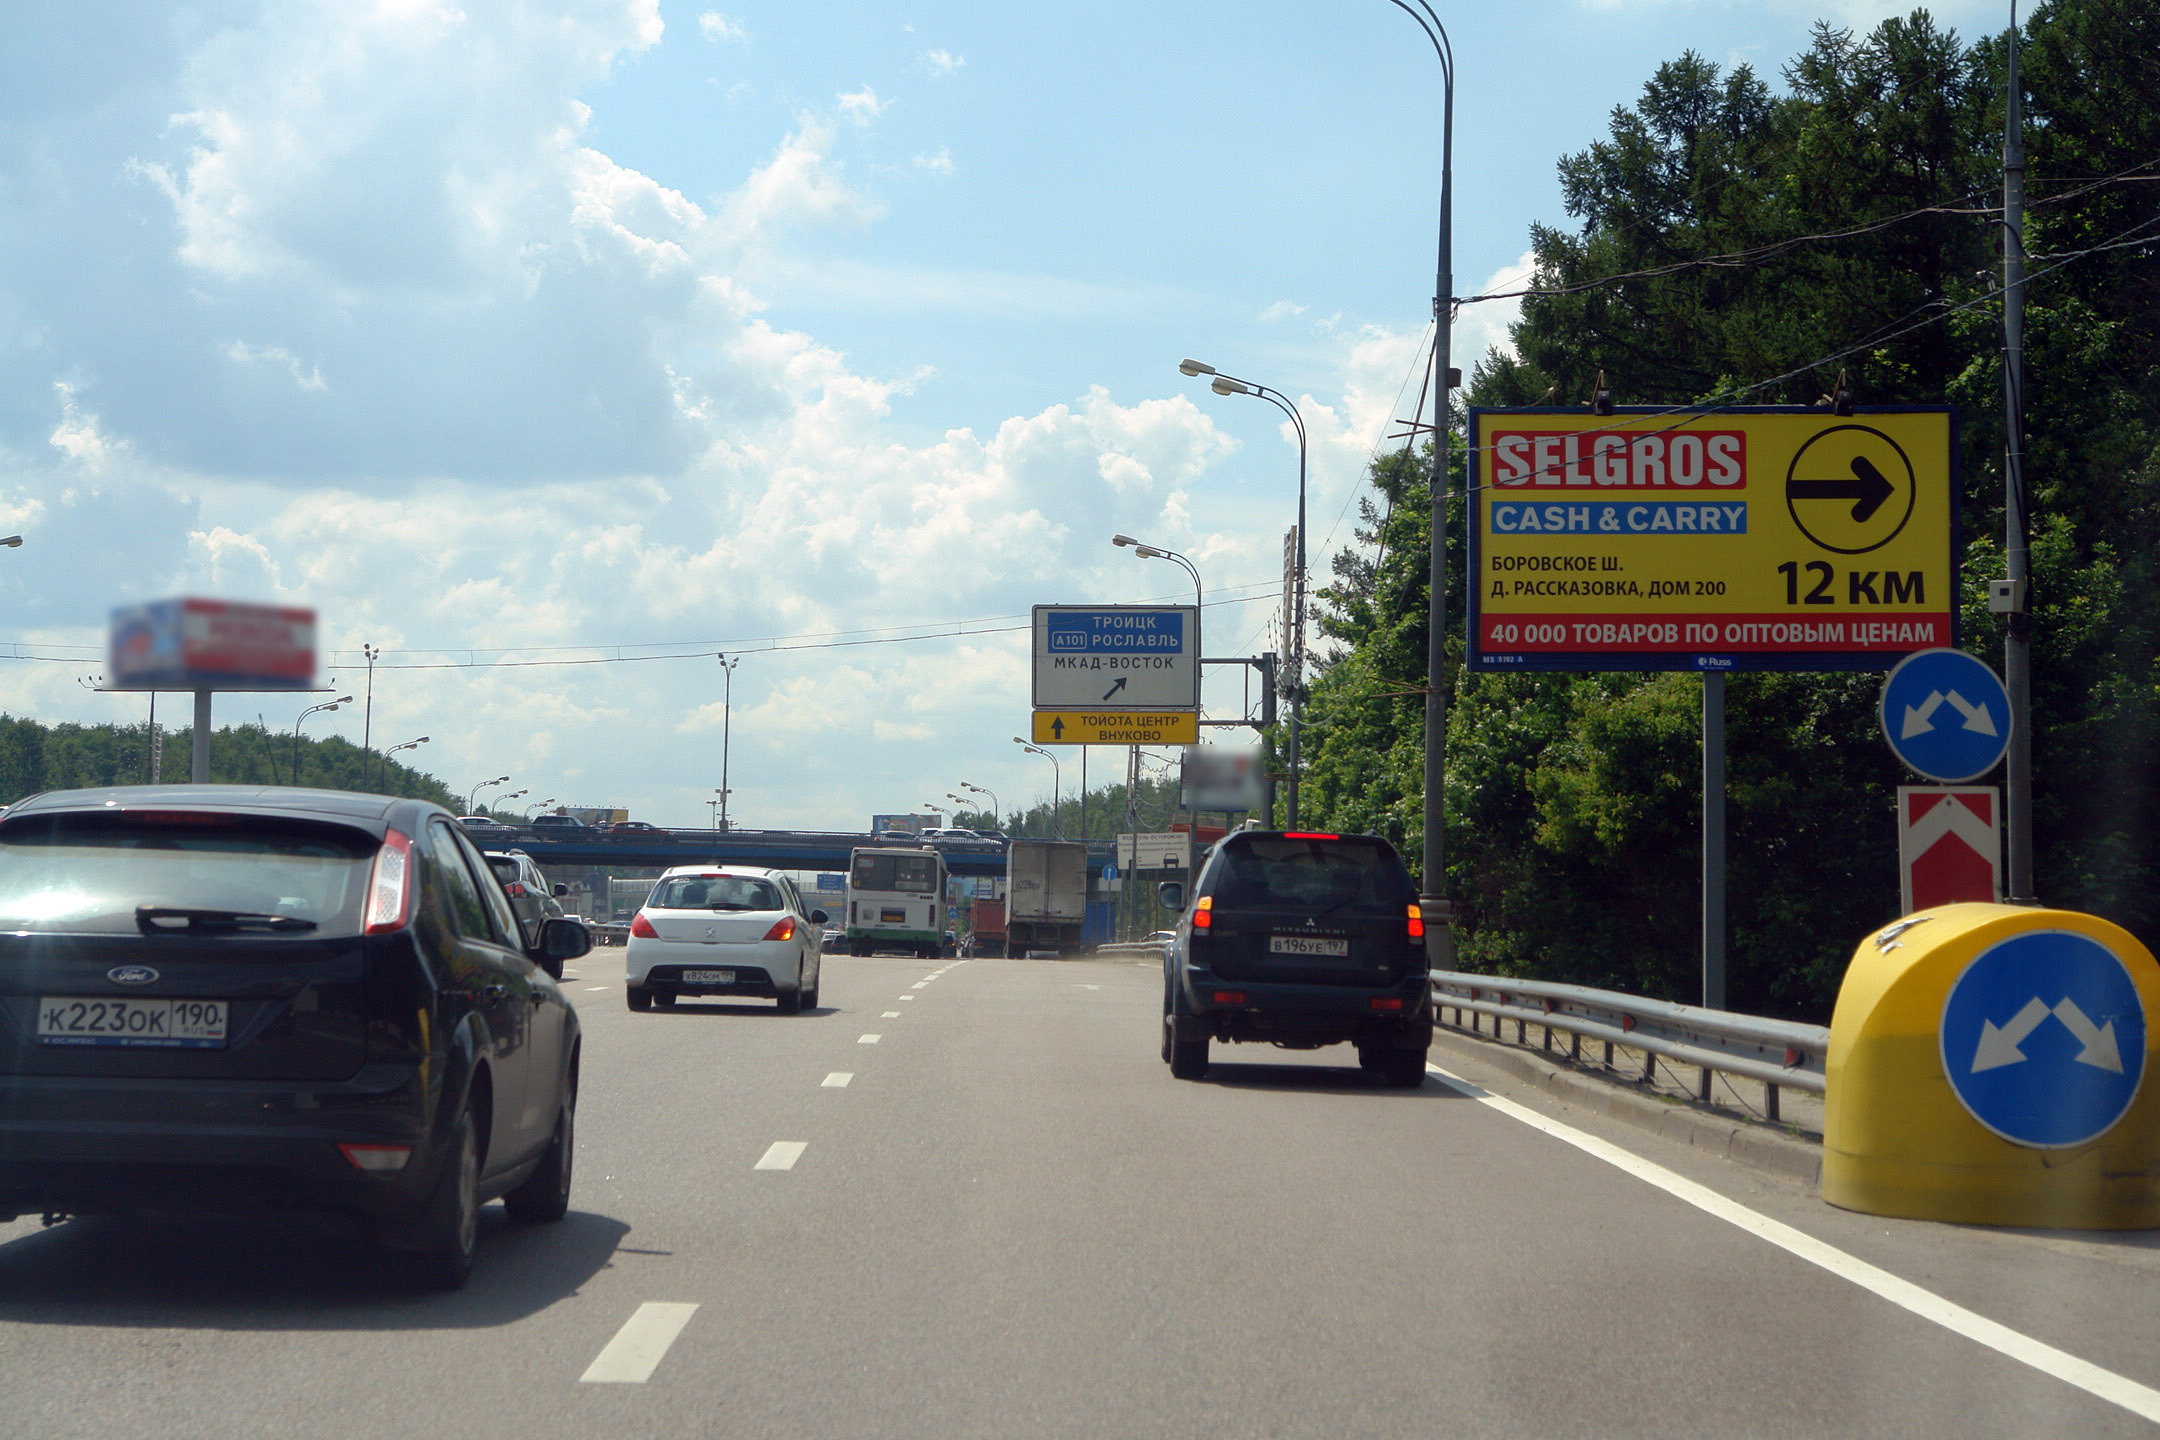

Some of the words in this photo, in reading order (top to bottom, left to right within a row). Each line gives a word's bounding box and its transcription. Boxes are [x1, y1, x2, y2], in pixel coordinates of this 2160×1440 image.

[1496, 434, 1741, 486] SELGROS
[1495, 506, 1590, 531] CASH
[1599, 507, 1621, 531] &
[1627, 506, 1745, 531] CARRY
[1491, 556, 1597, 572] БОРОВСКОЕ
[1601, 556, 1624, 572] Ш.
[1490, 581, 1510, 599] Д.
[1514, 581, 1644, 599] РАССКАЗОВКА,
[1648, 581, 1691, 599] ДОМ
[1694, 581, 1727, 596] 200
[1777, 561, 1836, 605] 12
[1093, 616, 1157, 630] ТРОИЦК
[1092, 633, 1179, 647] РОСЛАВЛЬ
[1490, 624, 1518, 643] 40
[1524, 624, 1566, 643] 000
[1572, 624, 1679, 643] ТОВАРОВ
[1686, 624, 1719, 643] ПО
[1725, 624, 1844, 643] ОПТОВЫМ
[1852, 623, 1935, 647] ЦЕНАМ
[1055, 656, 1174, 670] МКАД-ВОСТОК
[1709, 657, 1732, 666] Russ
[1081, 715, 1133, 727] ТОЙОТА
[1136, 716, 1180, 728] ЦЕНТР
[1099, 730, 1161, 741] ВНУКОВО
[174, 1003, 218, 1026] 190
